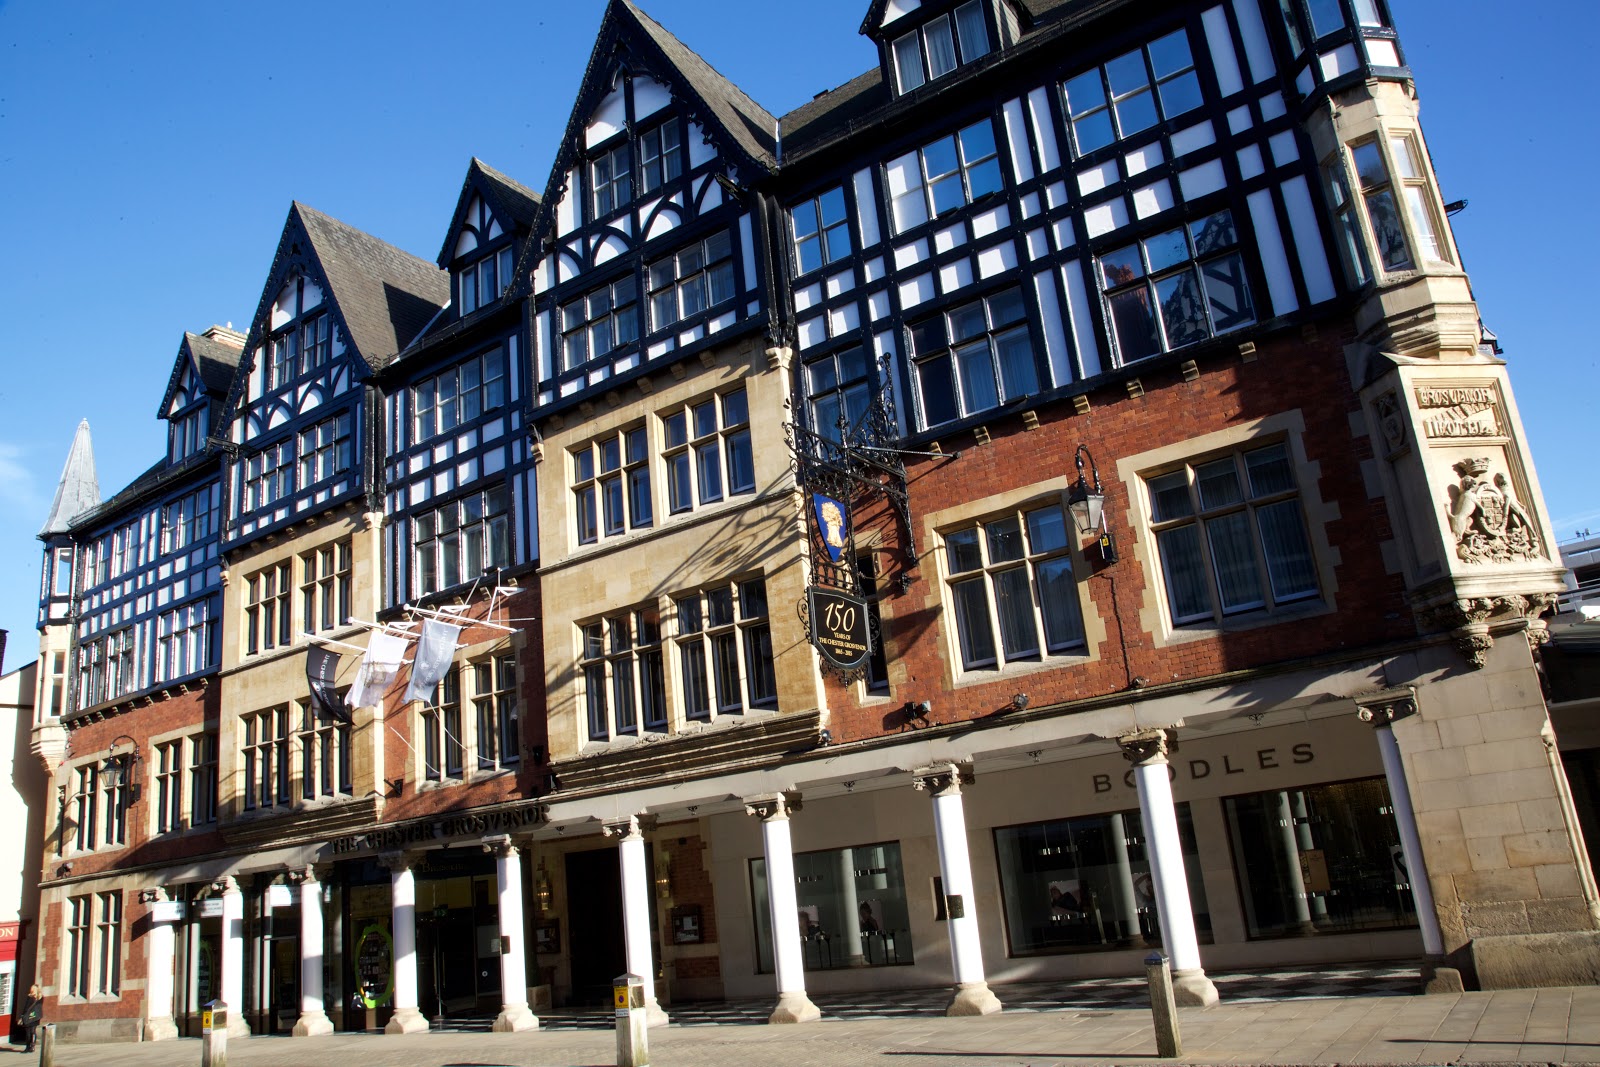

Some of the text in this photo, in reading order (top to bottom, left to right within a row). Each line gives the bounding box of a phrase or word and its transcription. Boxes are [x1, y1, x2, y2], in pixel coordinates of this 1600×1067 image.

[825, 600, 855, 632] 150
[828, 638, 844, 647] CHESTER
[844, 643, 866, 651] GROSVENOR
[329, 804, 551, 855] THE CHESTER GROSVENOR
